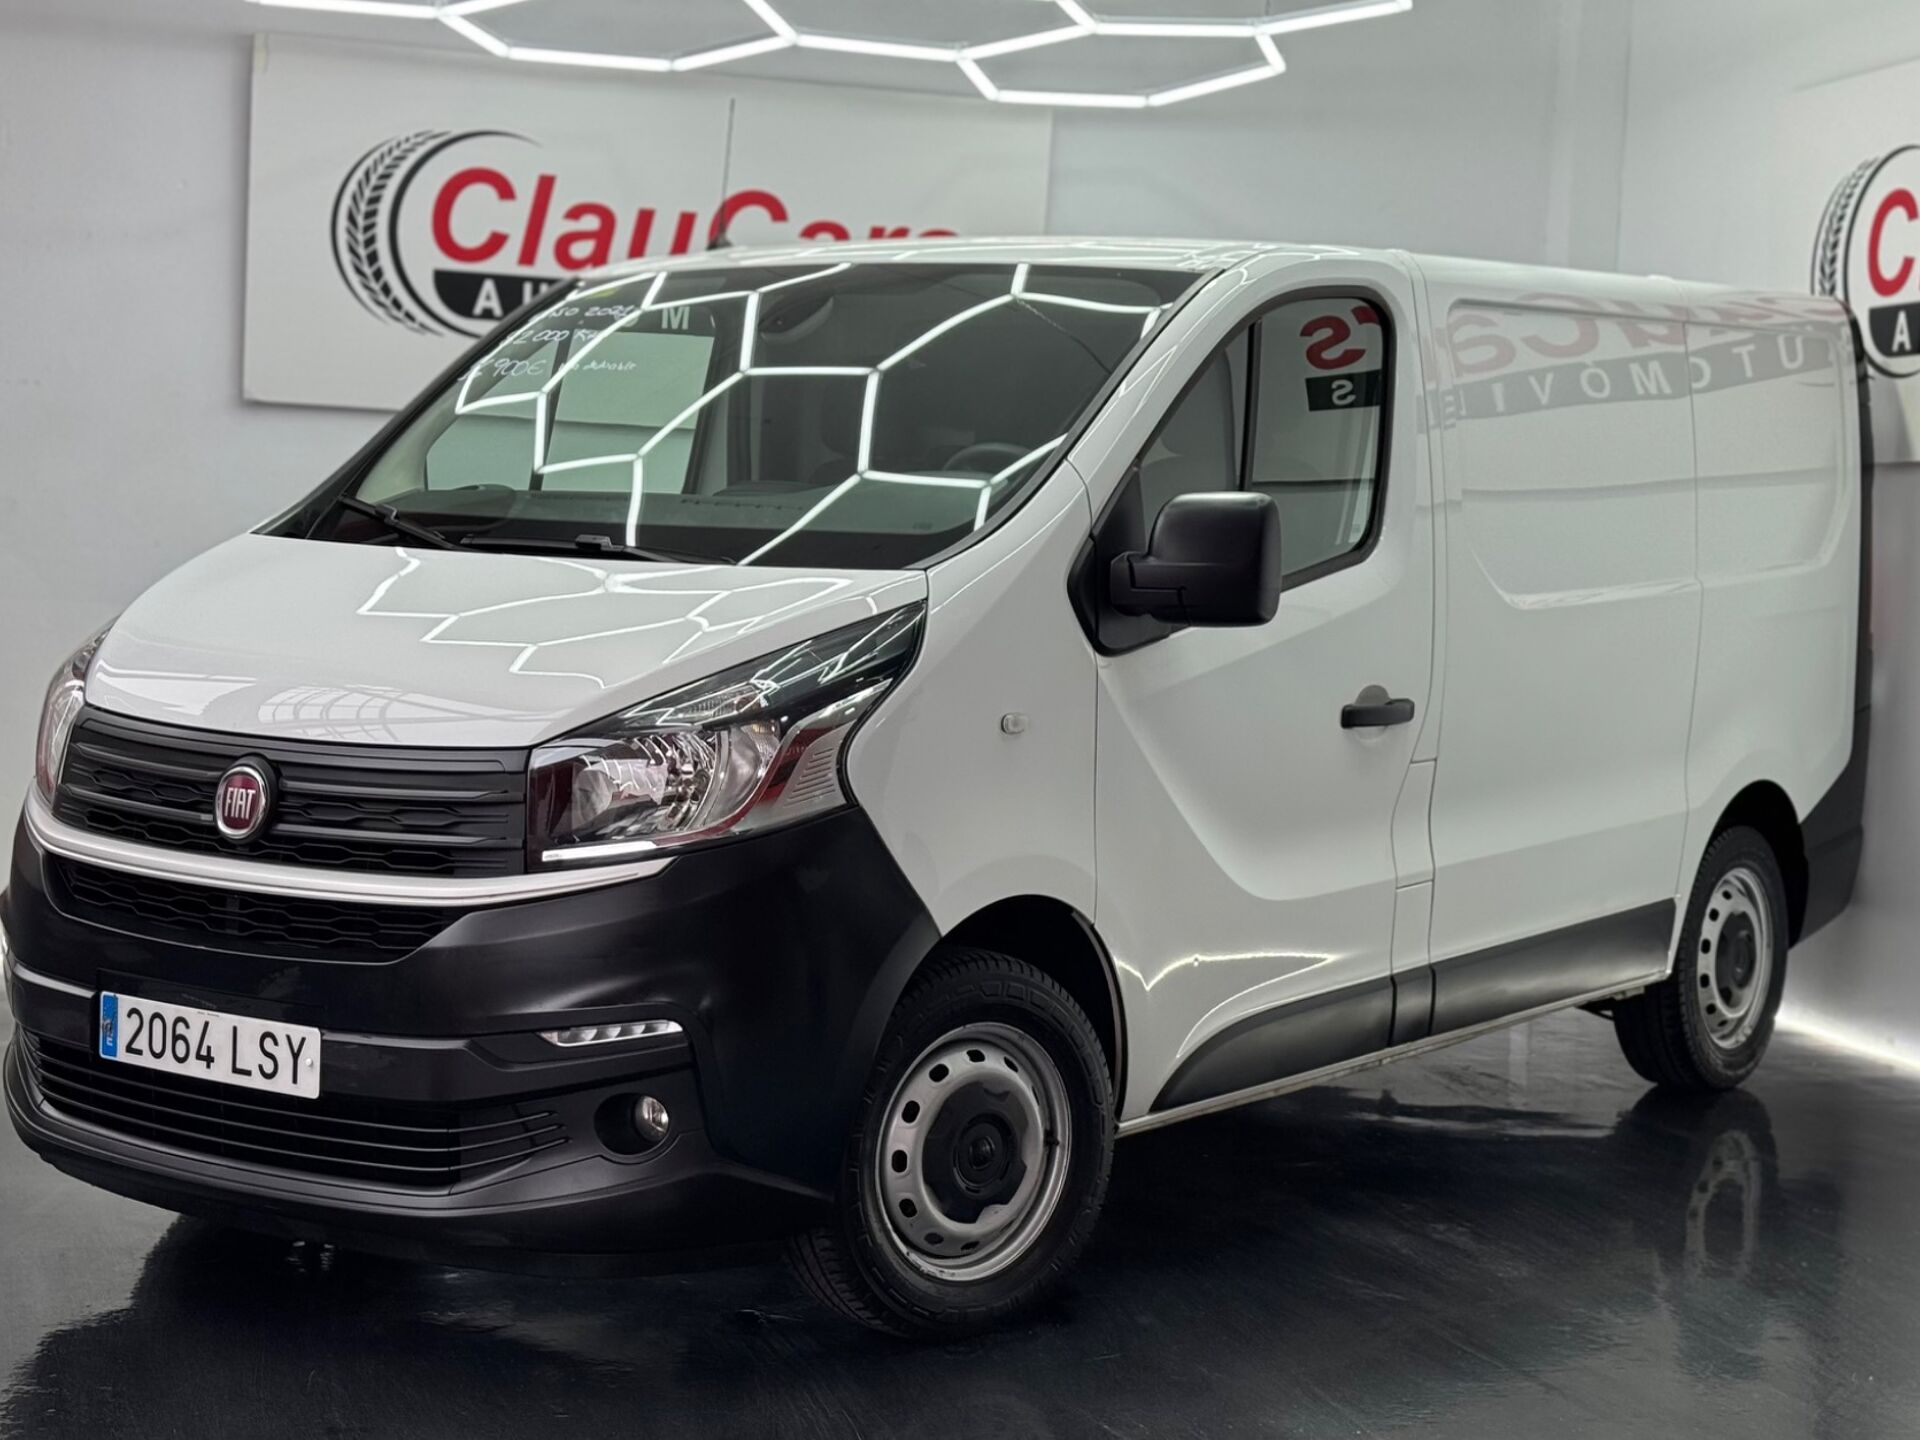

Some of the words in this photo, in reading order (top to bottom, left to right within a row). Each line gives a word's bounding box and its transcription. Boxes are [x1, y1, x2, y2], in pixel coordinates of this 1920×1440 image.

[224, 787, 256, 820] FIAT
[125, 1007, 215, 1070] 2064
[231, 1024, 307, 1085] LSY
